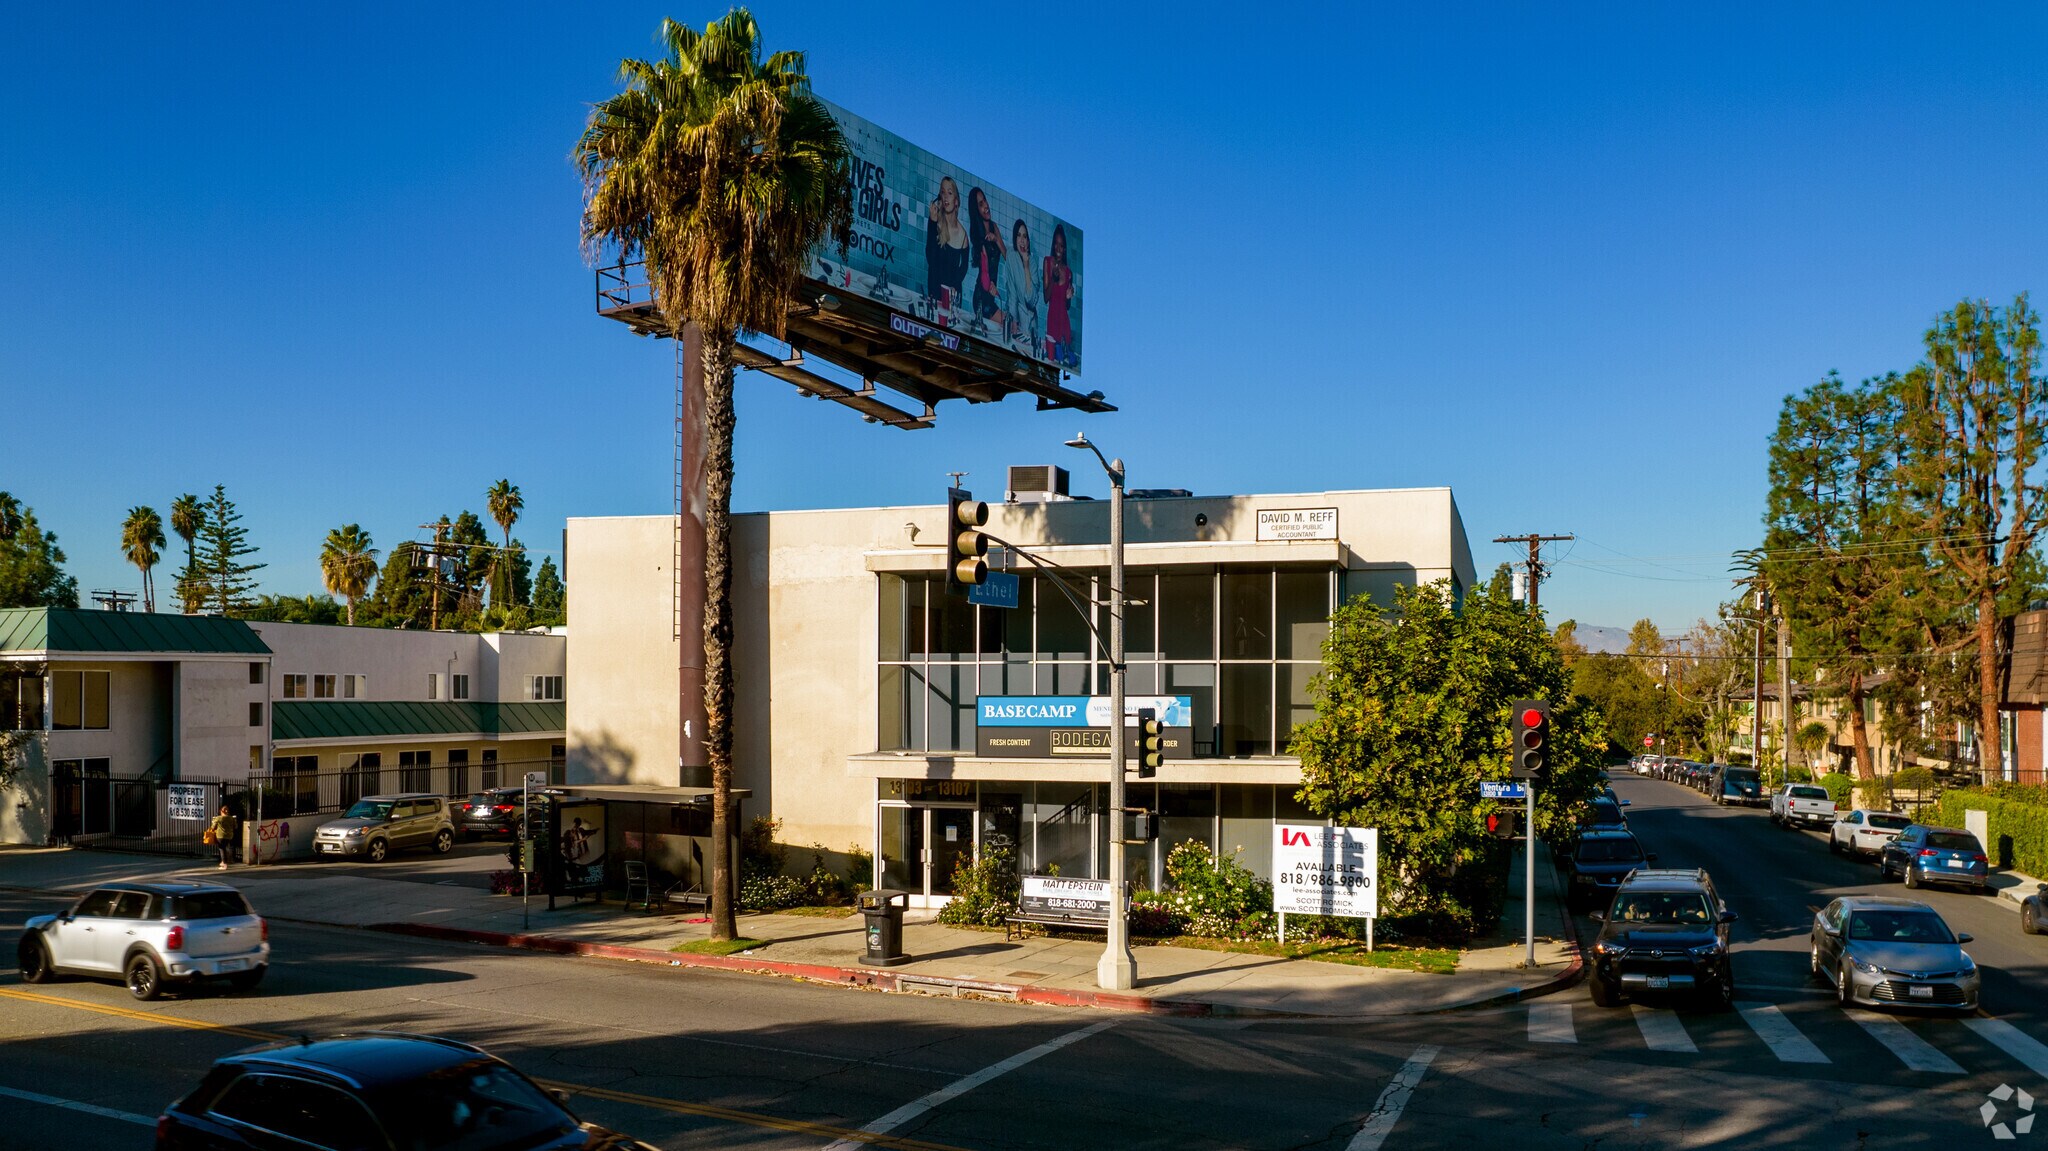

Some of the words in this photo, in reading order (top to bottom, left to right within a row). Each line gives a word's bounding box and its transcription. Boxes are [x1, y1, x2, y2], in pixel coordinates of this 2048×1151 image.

[850, 156, 885, 197] IVES
[857, 189, 902, 233] GIRLS
[892, 316, 957, 350] OUTFNT
[1261, 512, 1290, 524] DAVID
[1294, 512, 1306, 523] M.
[1309, 511, 1334, 523] REFF
[1302, 523, 1324, 531] PUBLIC
[975, 581, 1012, 600] Ethel
[984, 704, 1077, 719] BASECAMP
[989, 738, 1006, 746] FRESH
[1006, 739, 1031, 747] CONTENT
[1052, 732, 1112, 746] BODEGA
[170, 787, 204, 795] PROPERTY
[937, 782, 971, 796] 13107
[1483, 783, 1511, 792] Ventura
[170, 797, 183, 805] FOR
[184, 798, 204, 806] LEASE
[1314, 832, 1329, 841] LEE
[1330, 833, 1337, 841] &
[1317, 841, 1369, 850] ASSOCIATES
[1295, 862, 1356, 873] AVAILABLE
[1042, 880, 1067, 889] MATT
[1067, 881, 1104, 891] EPSTEIN
[1280, 872, 1371, 889] 818/986-9800
[1292, 886, 1358, 897] lee-associates.com
[1047, 898, 1097, 909] 818-681-2000
[1295, 897, 1321, 905] SCOTT
[1322, 899, 1354, 907] ROMICK
